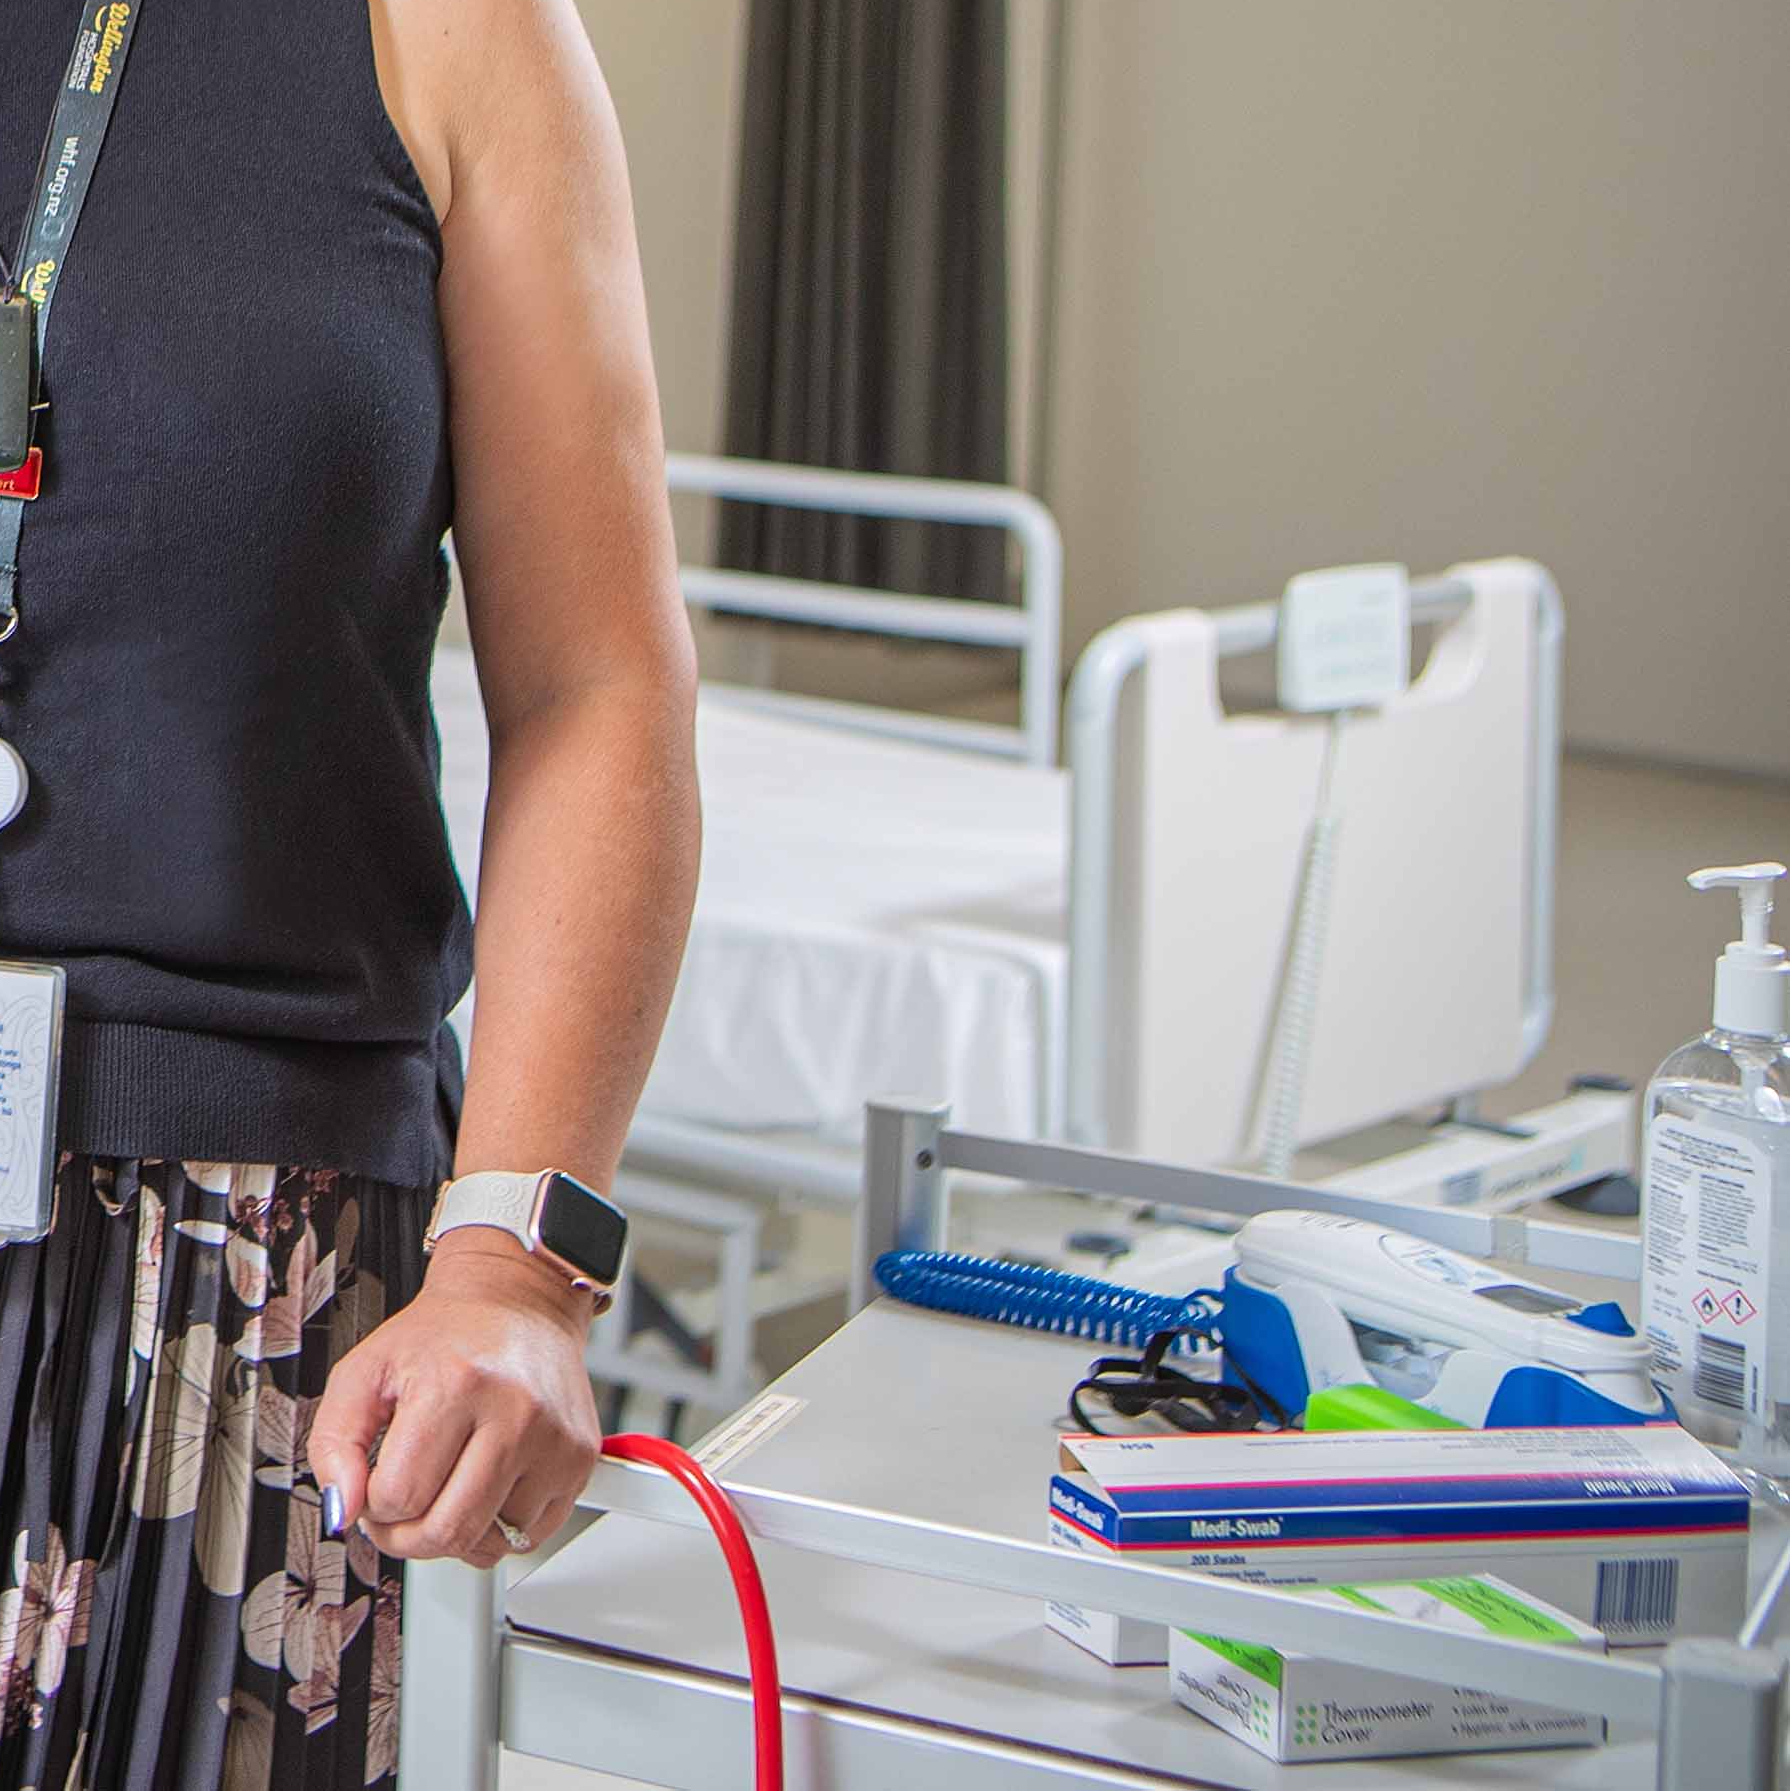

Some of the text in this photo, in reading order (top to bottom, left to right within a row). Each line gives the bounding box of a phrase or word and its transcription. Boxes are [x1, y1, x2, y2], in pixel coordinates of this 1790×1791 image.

[90, 3, 130, 93] Wellington
[44, 136, 80, 216] whf.org.nz
[1052, 1486, 1104, 1531] Medi-Swab
[1190, 1517, 1281, 1538] Medi-Swab
[1191, 1553, 1246, 1565] 200 Swabs
[1177, 1670, 1252, 1731] Thermometer
[1217, 1673, 1252, 1708] Cover
[1322, 1699, 1434, 1726] Thermometer
[1321, 1727, 1373, 1744] Cover
